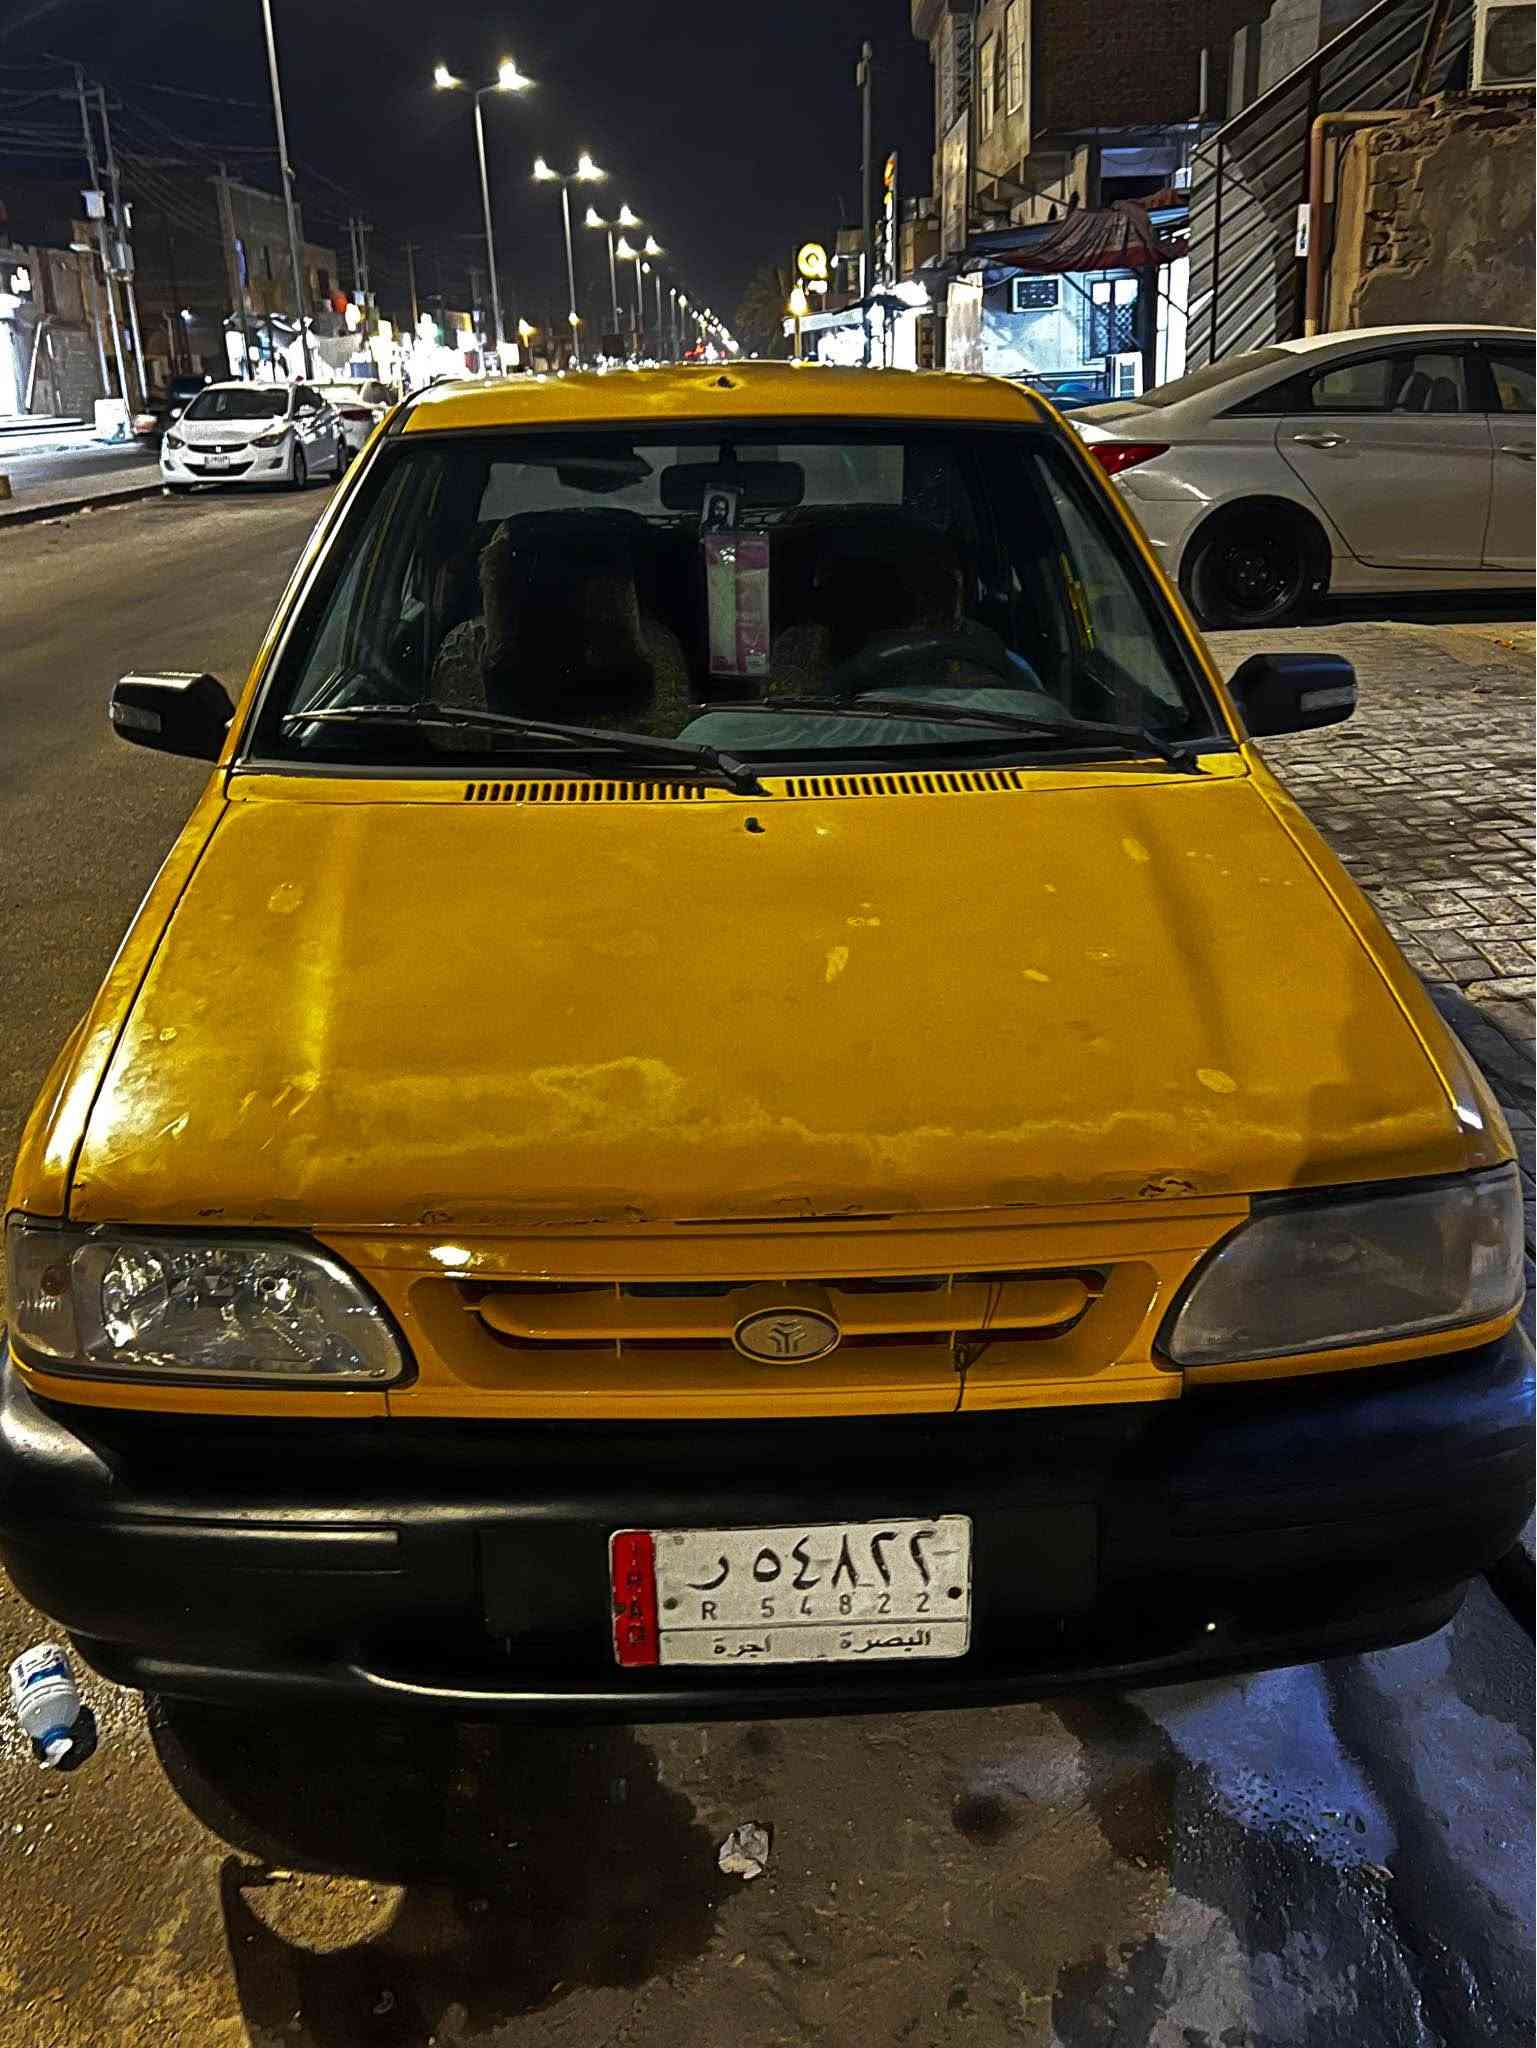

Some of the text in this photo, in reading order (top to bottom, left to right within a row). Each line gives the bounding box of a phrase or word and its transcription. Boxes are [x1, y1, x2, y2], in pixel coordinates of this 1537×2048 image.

[687, 1555, 729, 1590] ر
[701, 1601, 719, 1620] R
[839, 1629, 932, 1653] البصرة
